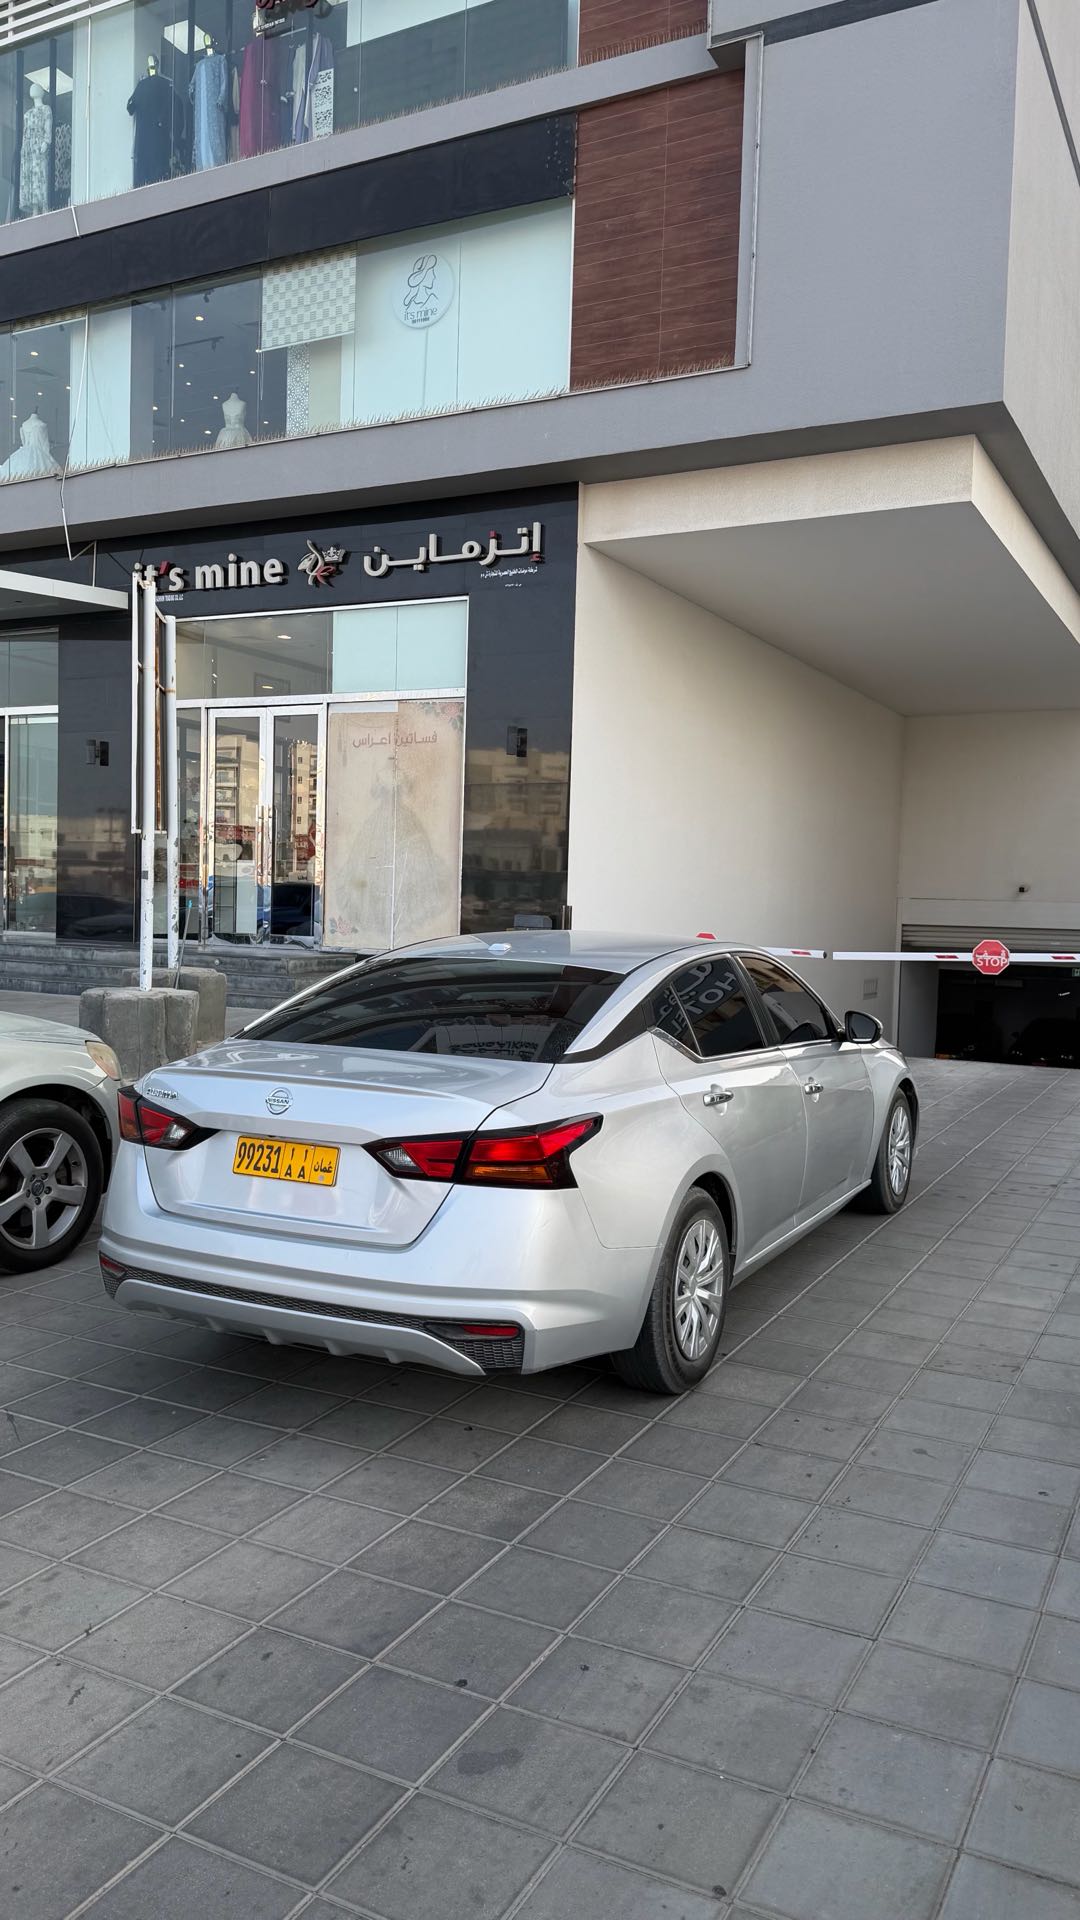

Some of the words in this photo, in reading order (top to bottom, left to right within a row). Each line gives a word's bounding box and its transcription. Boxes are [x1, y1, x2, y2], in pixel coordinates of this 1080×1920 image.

[417, 307, 438, 318] mine
[195, 553, 284, 589] mine
[976, 957, 1008, 967] STOP
[267, 1097, 290, 1105] NISSAN
[236, 1141, 282, 1174] 99231
